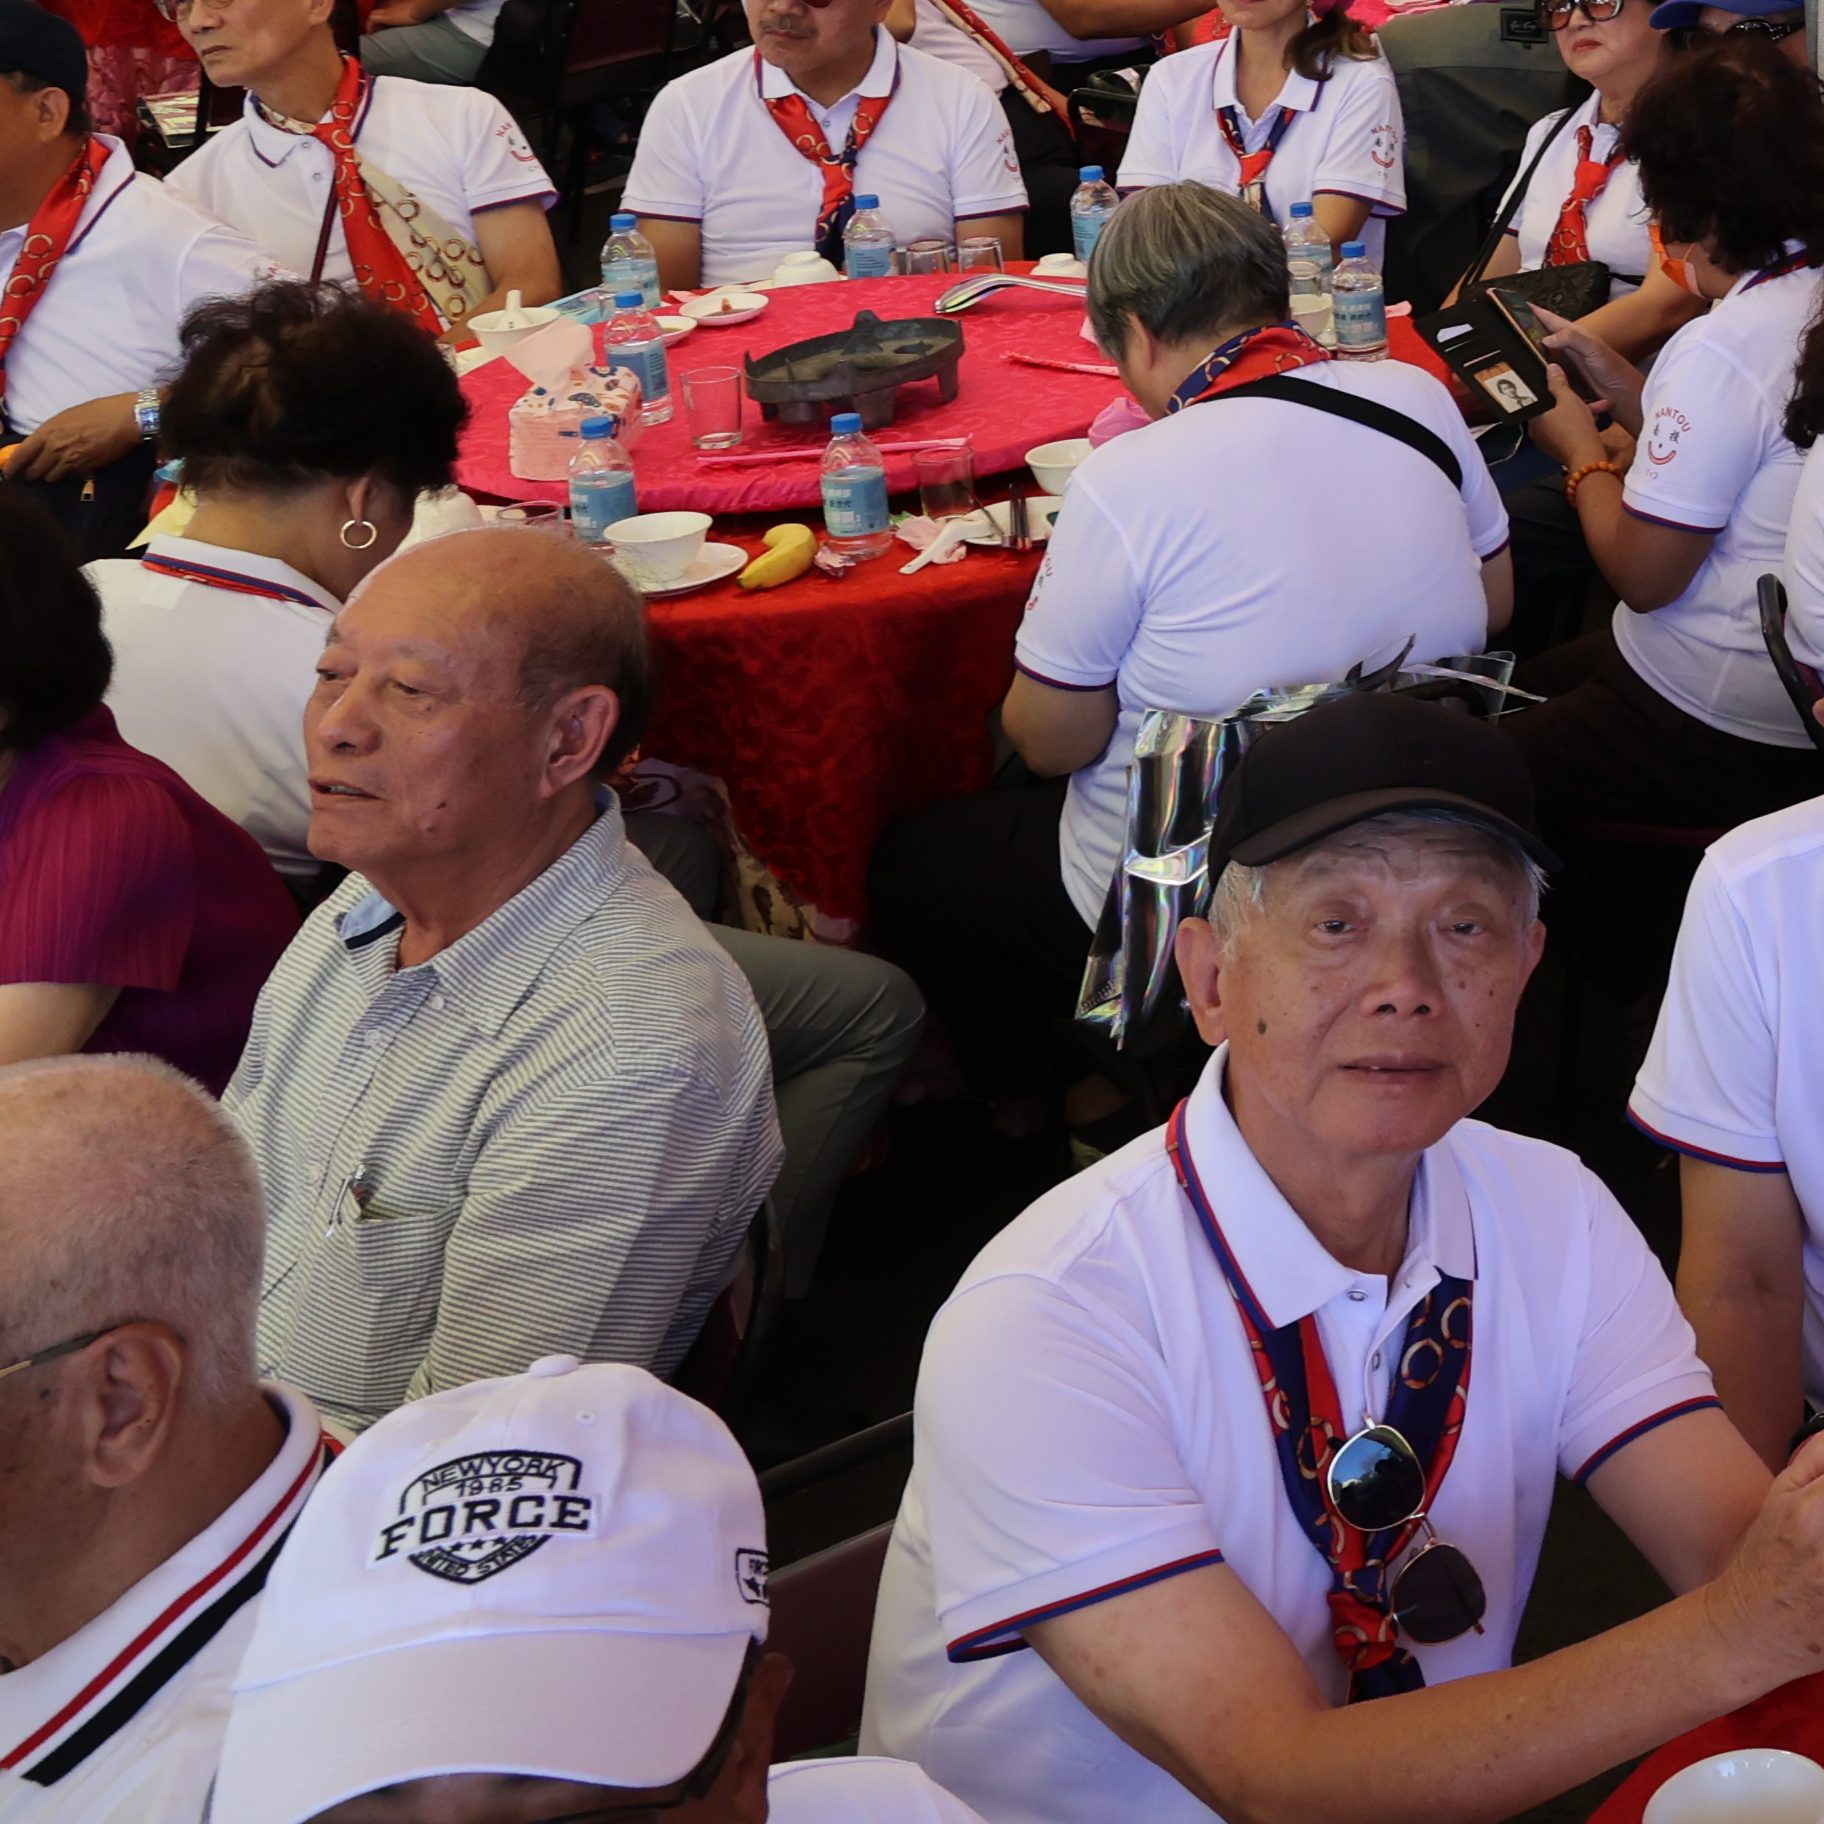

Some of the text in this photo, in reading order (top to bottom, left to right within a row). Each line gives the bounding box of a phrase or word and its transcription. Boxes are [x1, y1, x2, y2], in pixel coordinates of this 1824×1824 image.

[1655, 407, 1692, 433] NANTOU
[455, 1476, 524, 1497] 1985
[375, 1494, 593, 1562] FORCE
